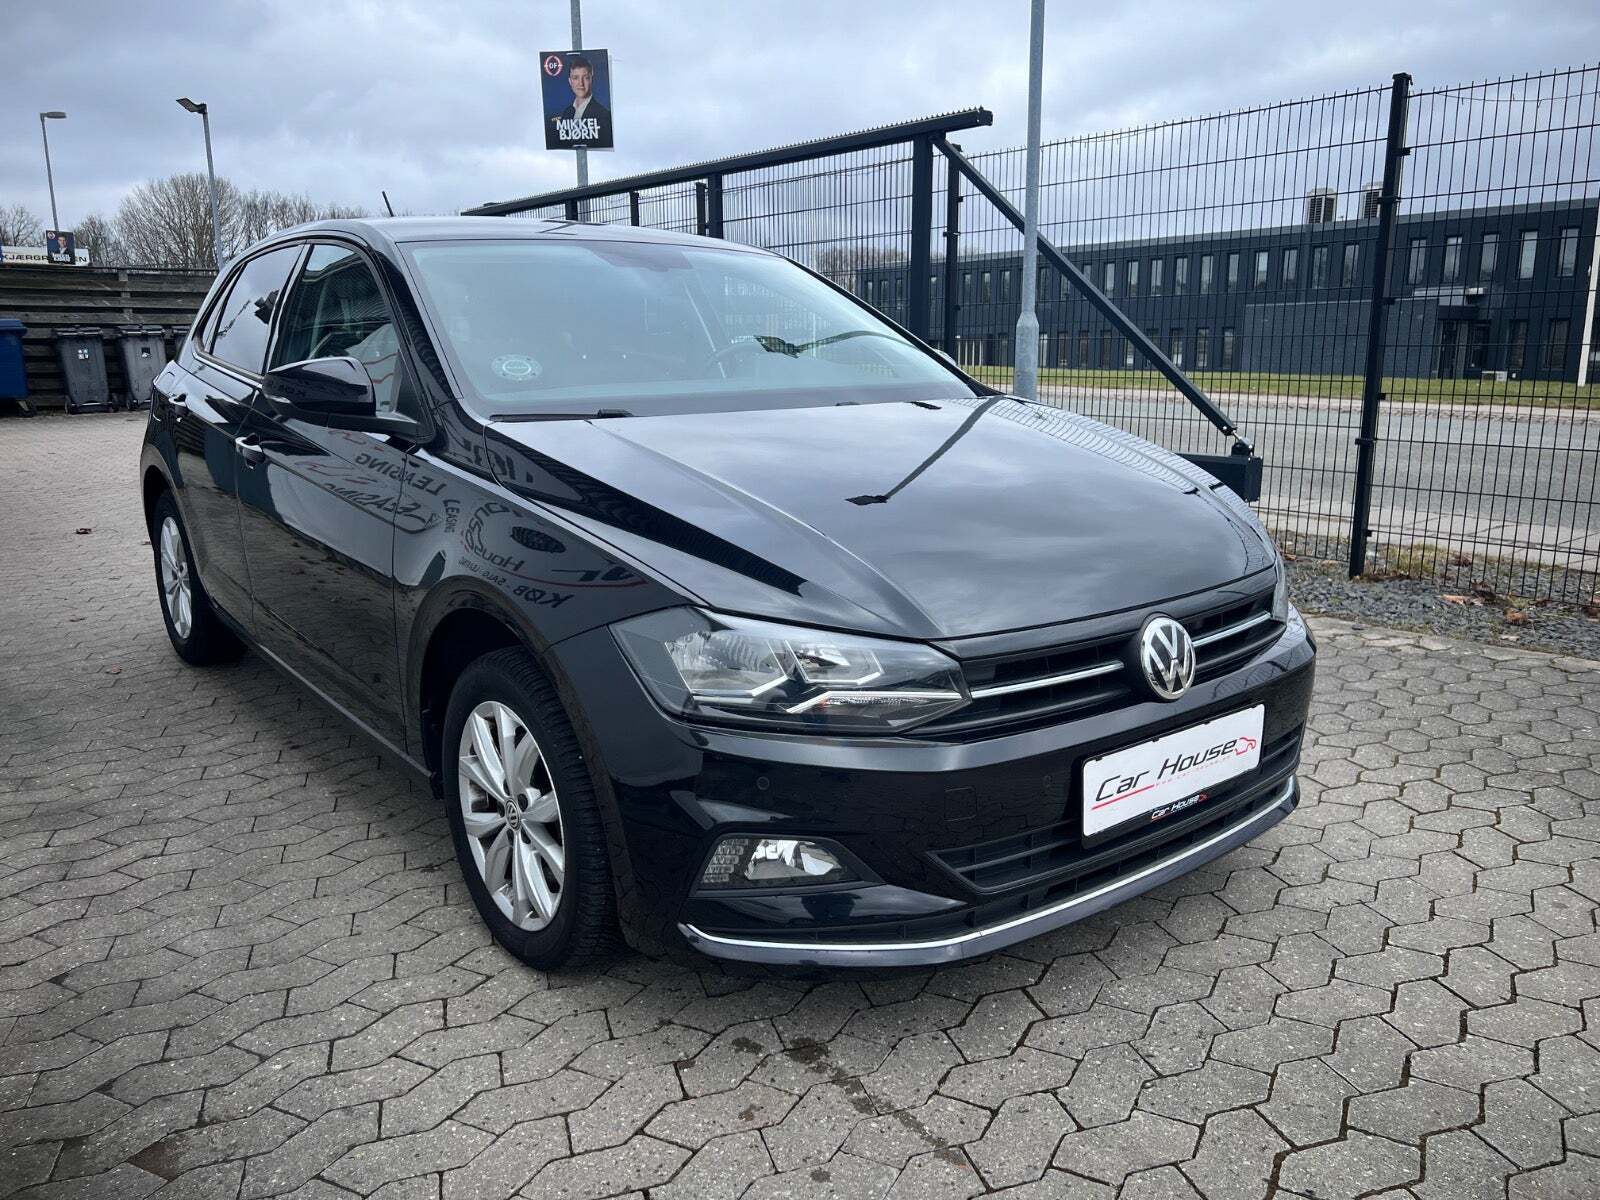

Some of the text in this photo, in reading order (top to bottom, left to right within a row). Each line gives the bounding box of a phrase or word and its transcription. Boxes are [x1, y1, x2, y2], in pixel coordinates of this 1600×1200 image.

[556, 117, 600, 130] MIKKEL
[560, 128, 599, 140] BJØRN
[1095, 769, 1150, 802] Car
[1157, 739, 1237, 780] House
